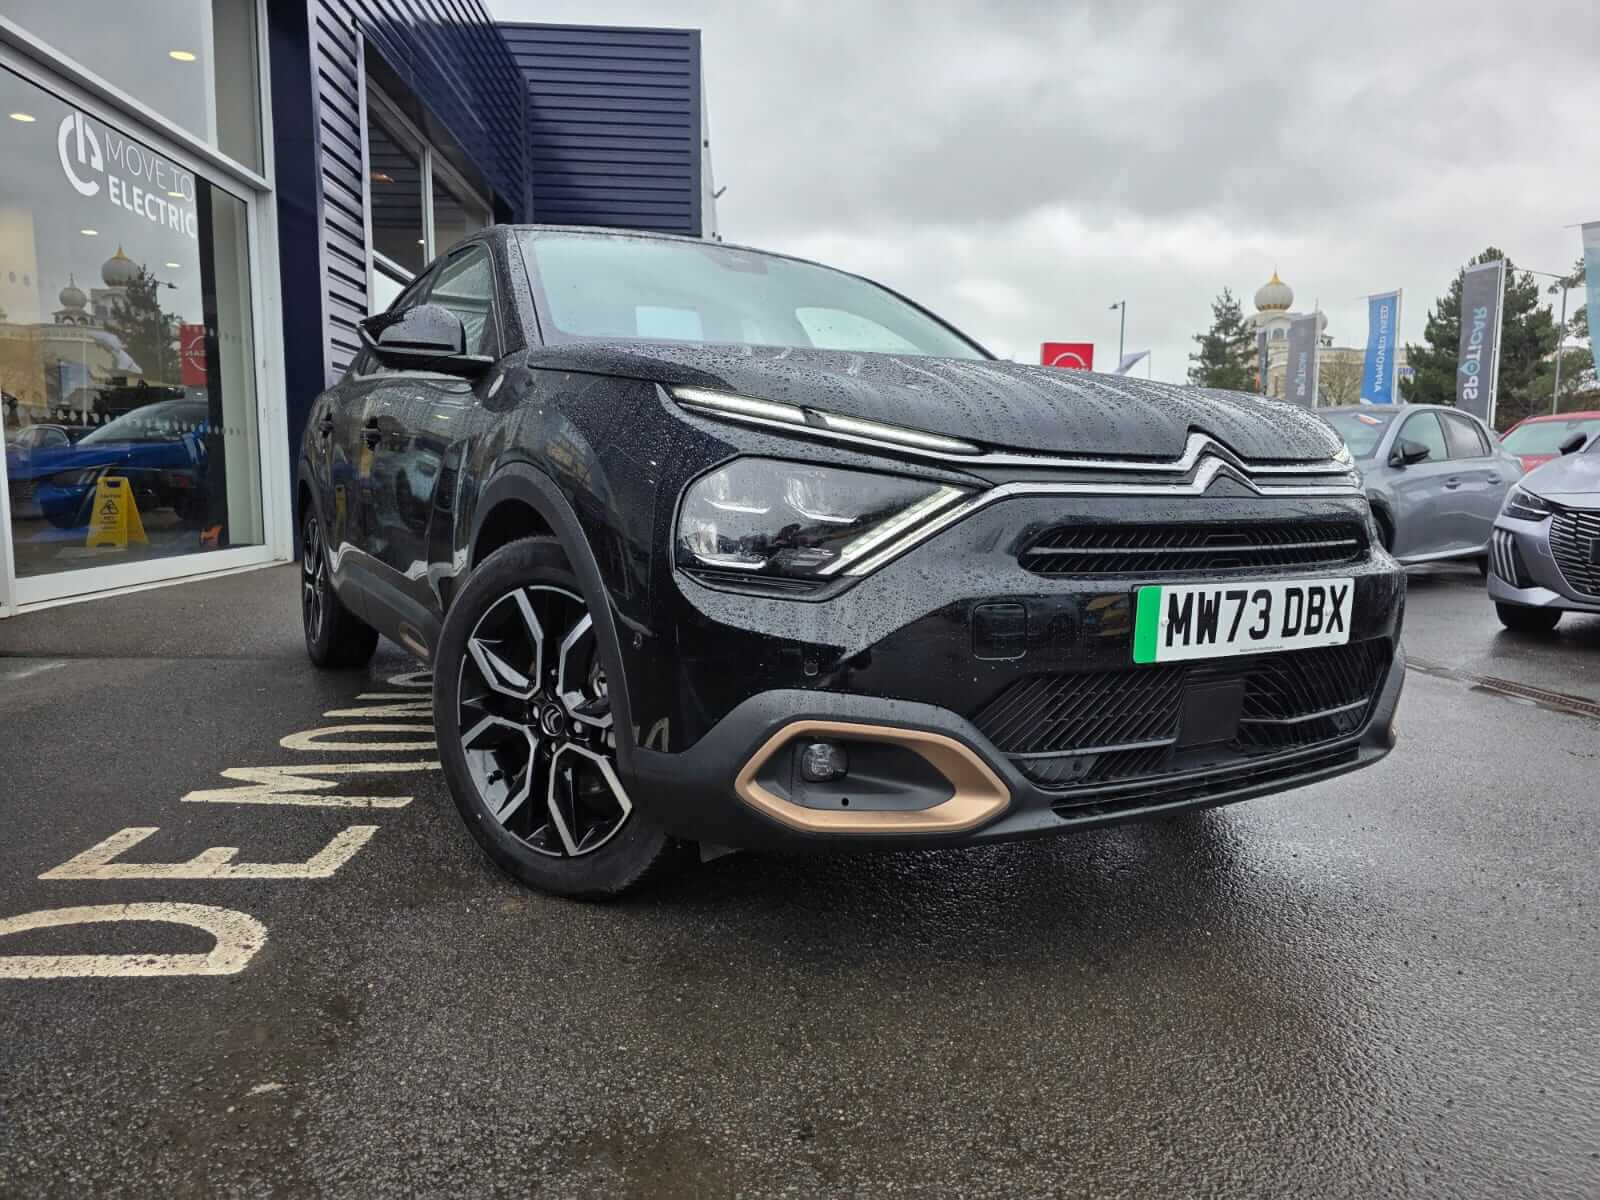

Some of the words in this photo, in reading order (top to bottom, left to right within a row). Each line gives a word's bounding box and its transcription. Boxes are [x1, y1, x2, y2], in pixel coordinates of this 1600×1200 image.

[105, 132, 168, 189] MOVE
[169, 166, 194, 203] TO
[108, 175, 197, 240] ELECTRIC
[1165, 589, 1273, 647] MW73
[1281, 585, 1348, 637] DBX
